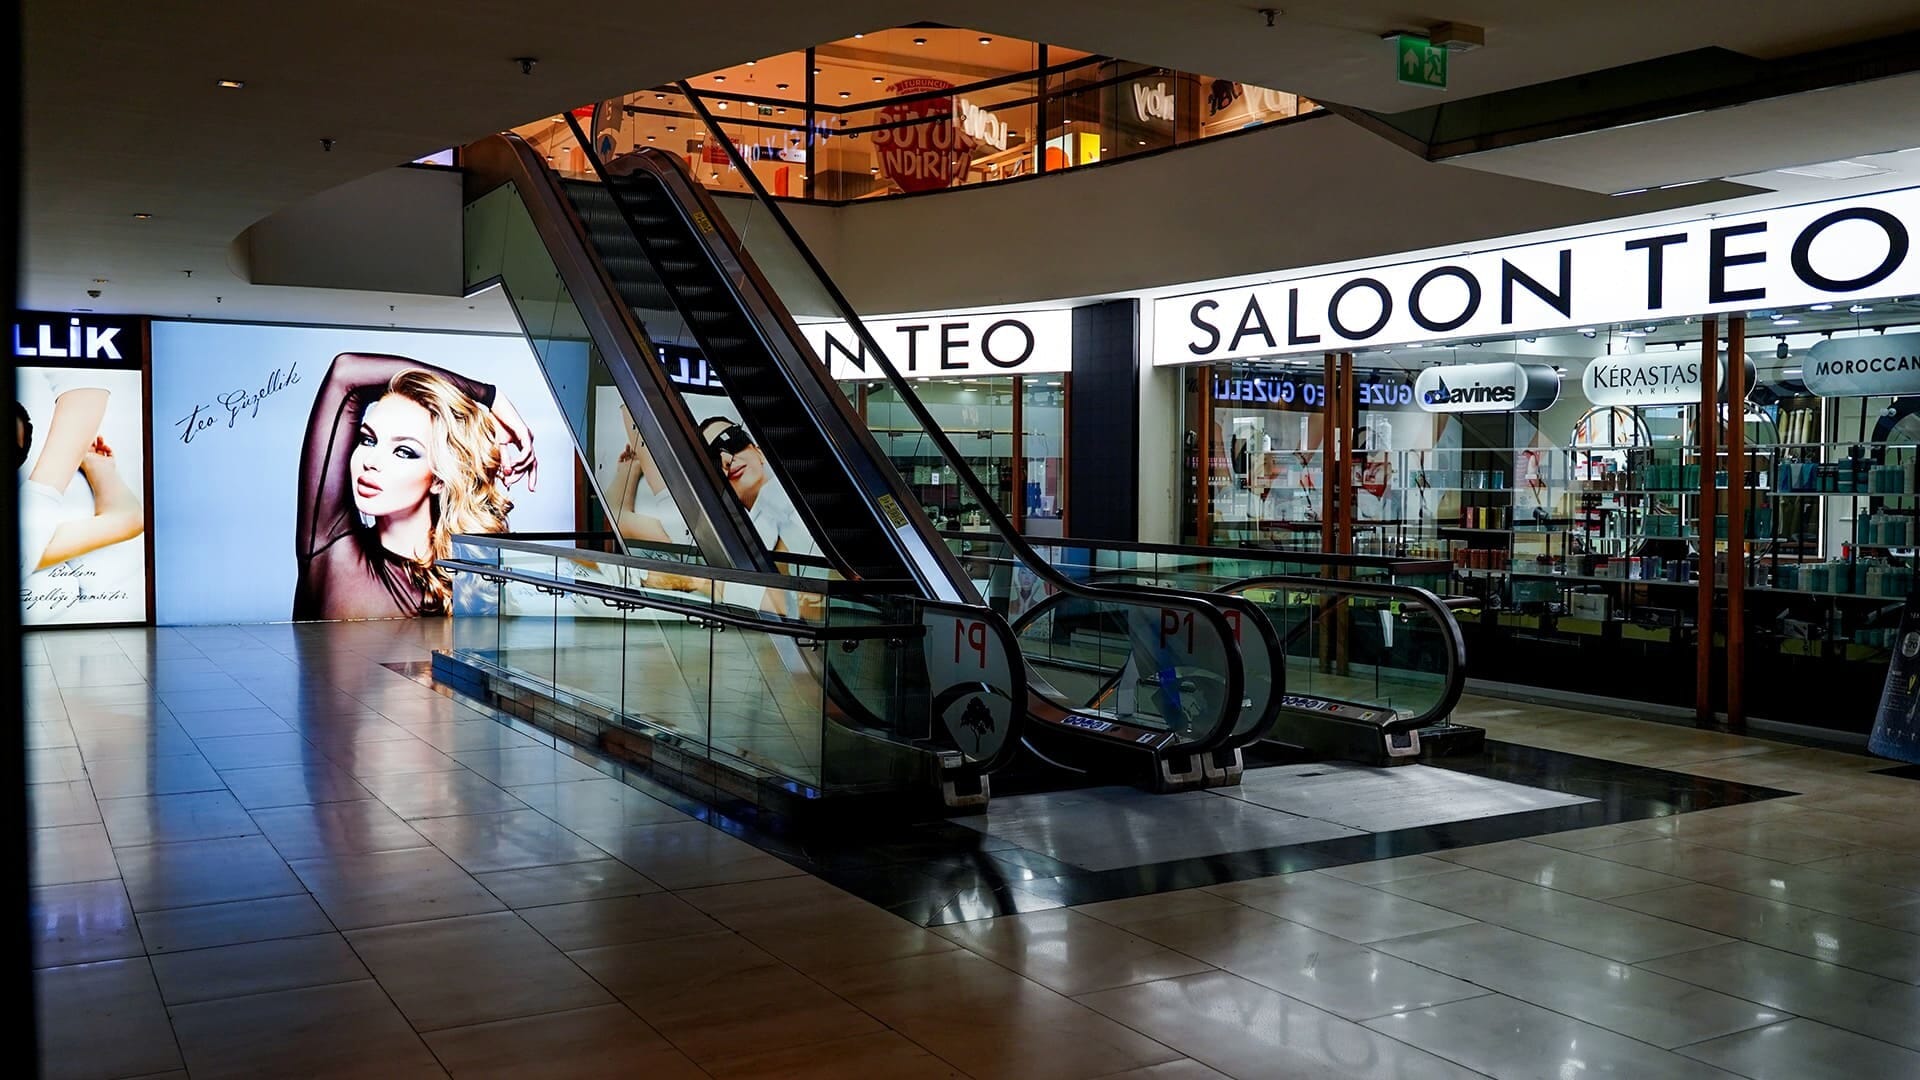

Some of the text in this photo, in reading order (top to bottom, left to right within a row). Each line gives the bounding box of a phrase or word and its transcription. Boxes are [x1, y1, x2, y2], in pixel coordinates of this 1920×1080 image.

[872, 105, 977, 150] BÜYÜK
[1188, 207, 1909, 355] SALOON TEO
[896, 319, 1035, 371] TEO
[1816, 356, 1920, 376] MOROCCAN
[217, 361, 301, 428] Güzellik
[1594, 364, 1702, 389] KÉRASTAS
[1626, 386, 1680, 396] PARIS
[1160, 608, 1194, 654] P1
